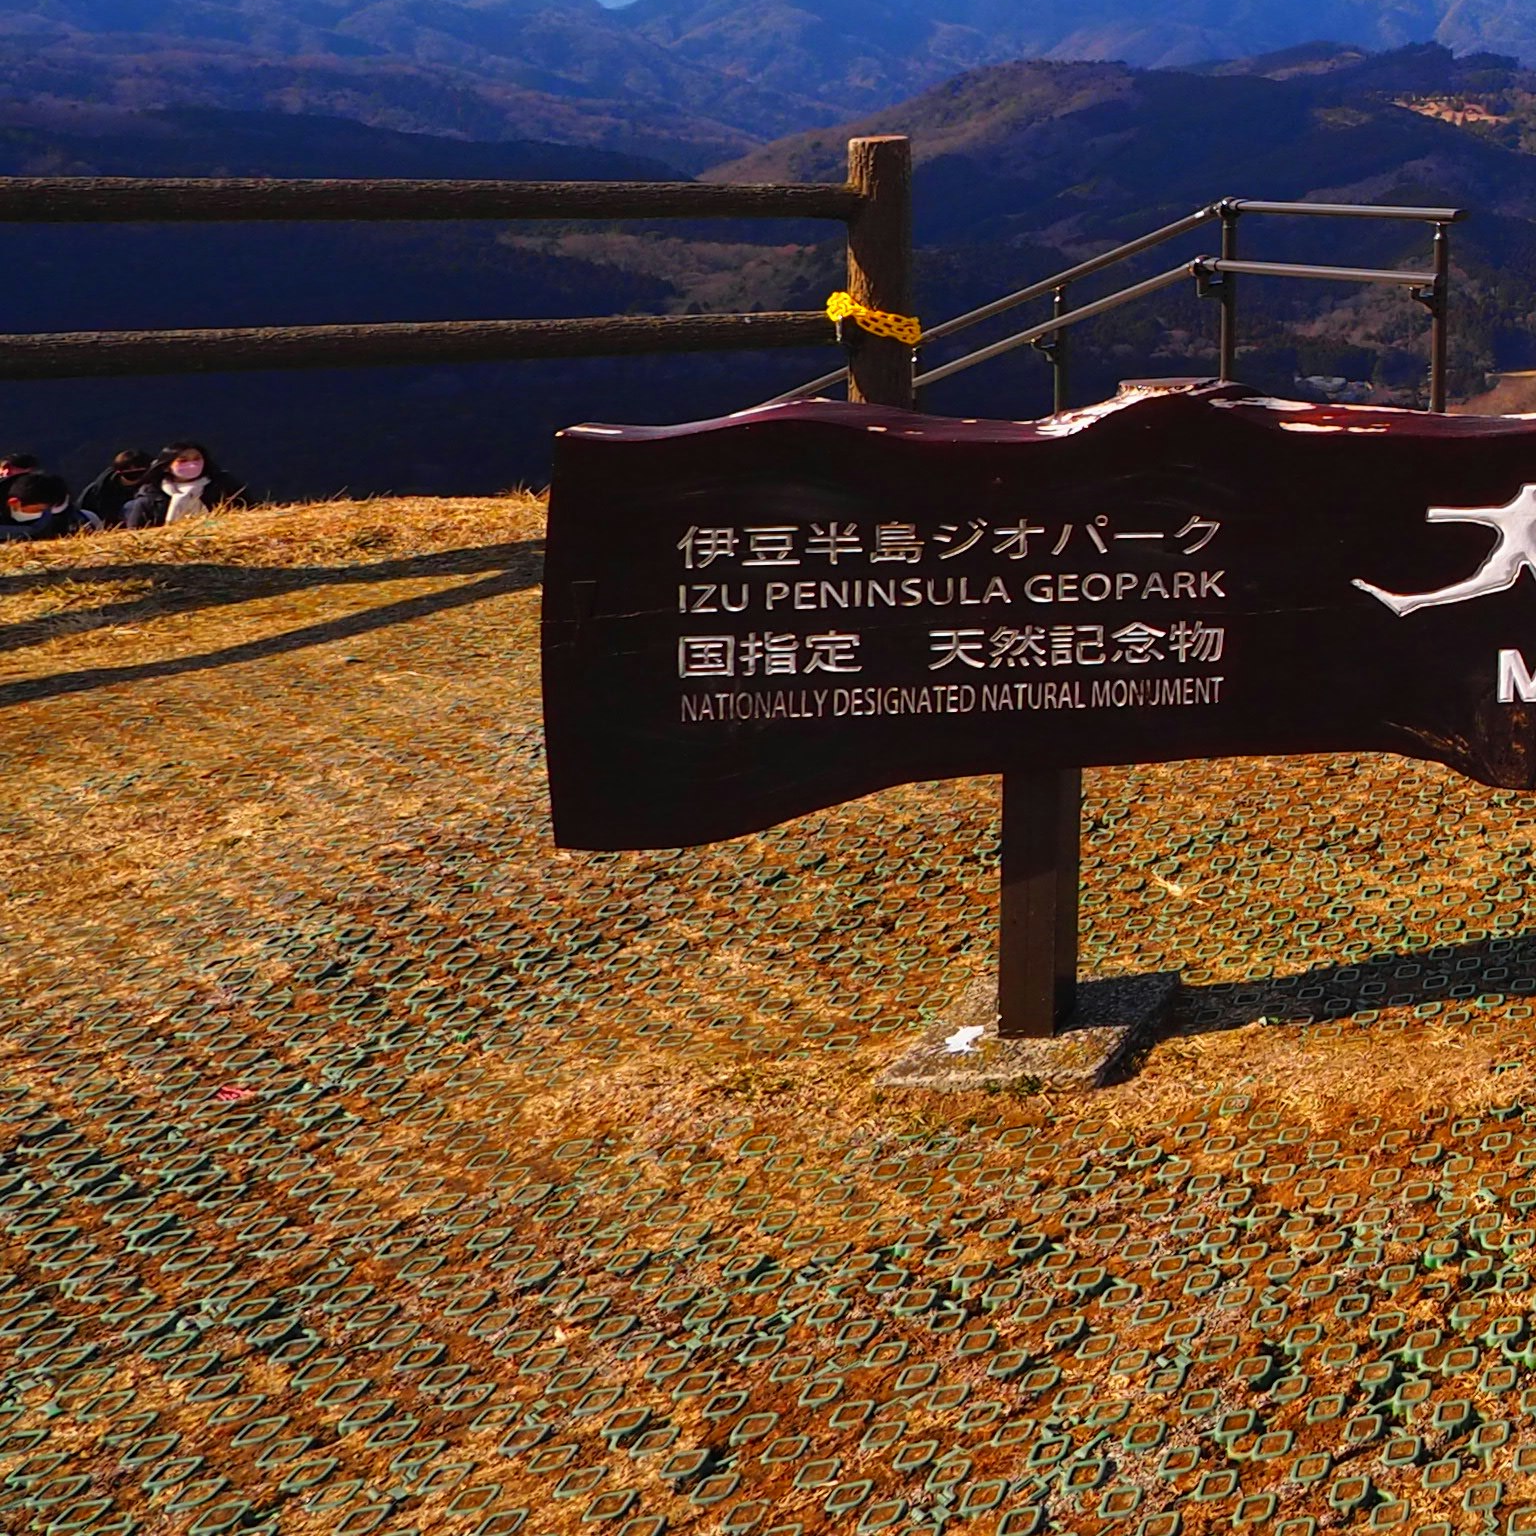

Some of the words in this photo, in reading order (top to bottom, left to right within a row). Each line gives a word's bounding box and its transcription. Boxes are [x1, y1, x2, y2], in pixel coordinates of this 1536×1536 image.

[676, 513, 1222, 570] 伊豆半島ジオパーク
[678, 582, 749, 614] IZU
[766, 575, 1012, 611] PENINSULA
[1024, 569, 1226, 604] GEOPARK
[677, 630, 863, 679] 国指定
[928, 620, 1225, 672] 天然記念物
[680, 687, 828, 722] NATIONALLY
[834, 684, 976, 716] DESIGNATED
[981, 681, 1085, 712] NATURAL
[1091, 677, 1225, 709] MONUMENT
